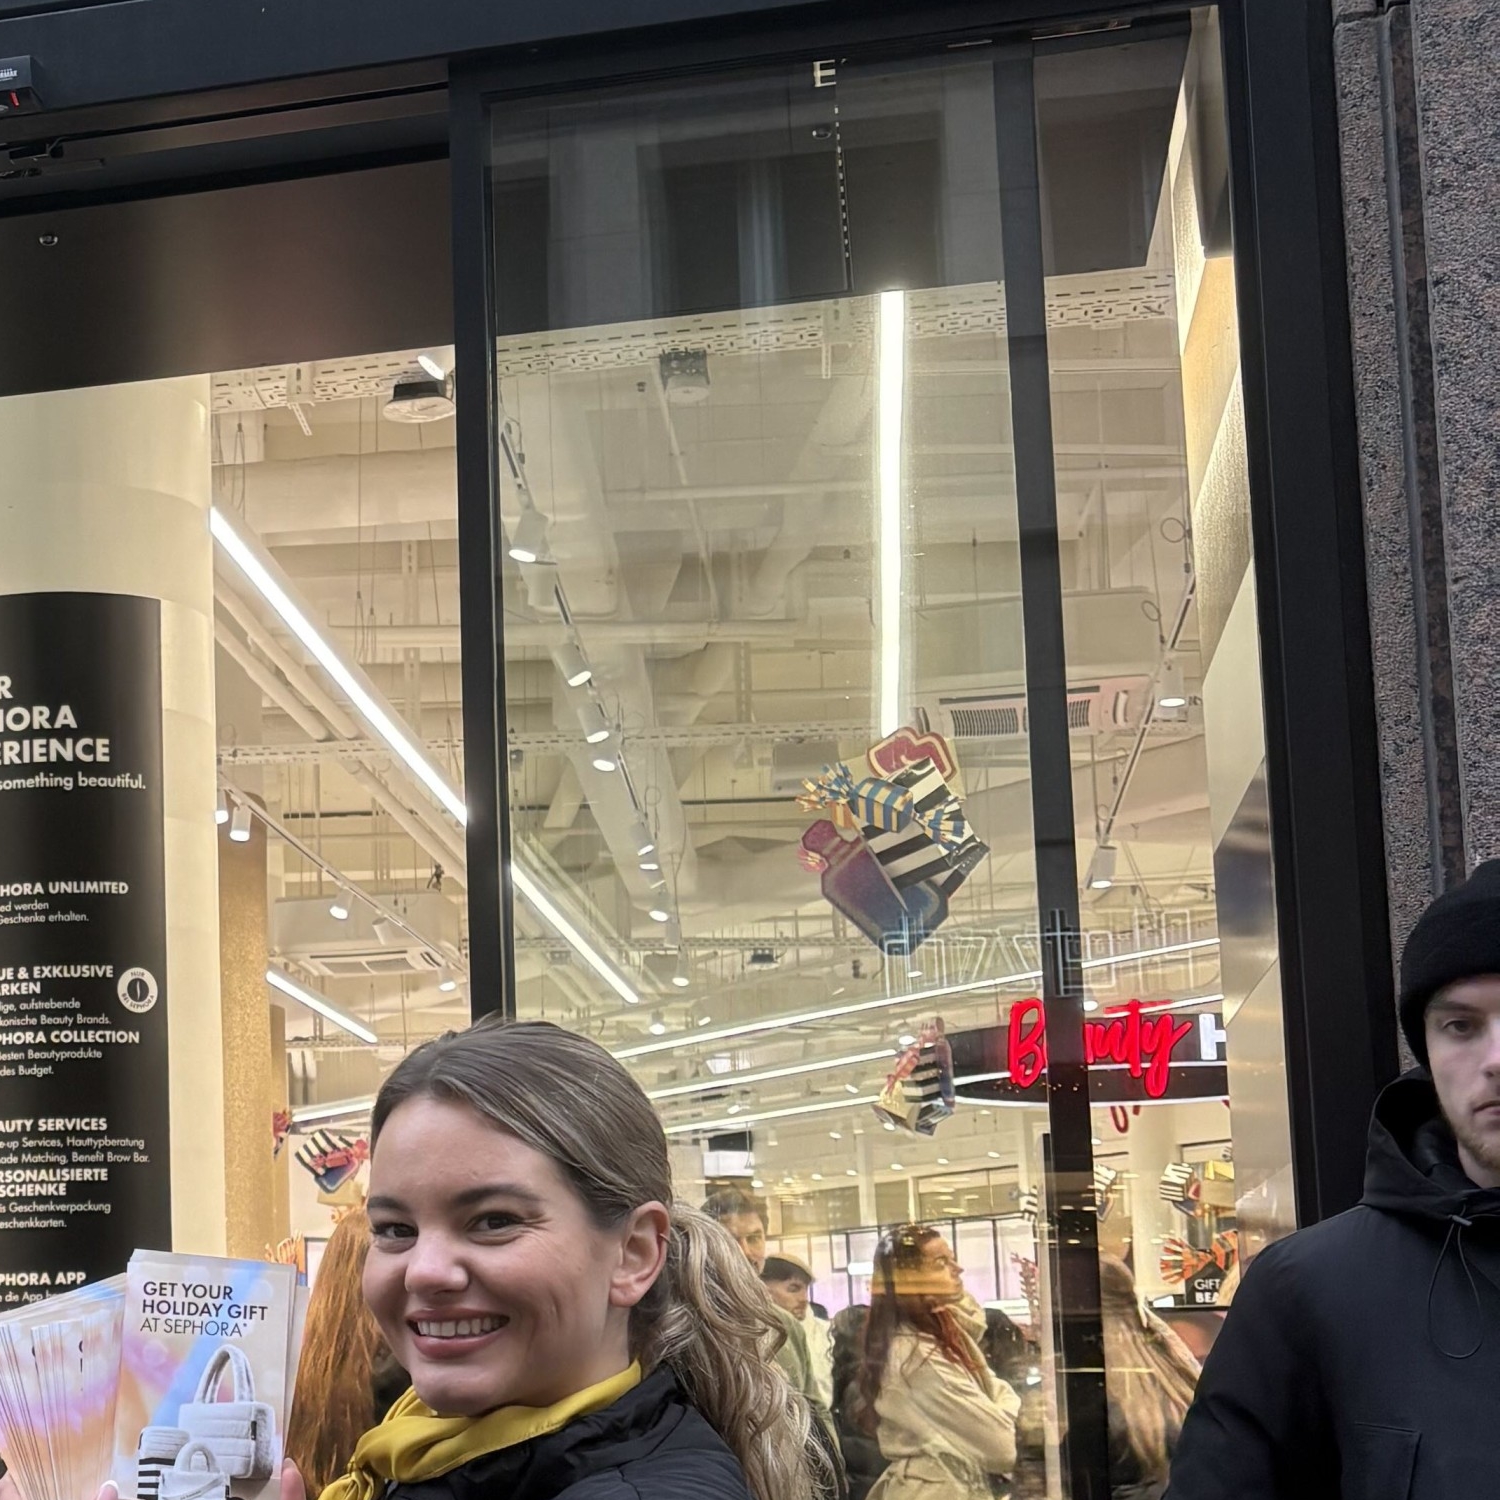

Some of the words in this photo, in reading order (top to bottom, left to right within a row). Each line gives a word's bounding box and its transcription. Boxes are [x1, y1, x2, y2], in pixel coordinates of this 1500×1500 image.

[78, 771, 146, 789] beautiful.
[48, 881, 129, 895] UNLIMITED
[14, 900, 49, 911] werden
[48, 912, 89, 923] erhalten.
[17, 968, 30, 981] &
[33, 965, 114, 979] EXKLUSIVE
[19, 998, 81, 1010] aufstrebende
[40, 1014, 74, 1027] Beauty
[76, 1013, 112, 1025] Brands.
[50, 1030, 140, 1044] COLLECTION
[27, 1047, 102, 1061] Beautyprodukte
[18, 1063, 54, 1077] Budget.
[37, 1117, 108, 1132] SERVICES
[21, 1136, 64, 1149] Services,
[66, 1136, 145, 1150] Hauttypberatung
[21, 1152, 69, 1166] Matching,
[72, 1151, 104, 1163] Benefit
[106, 1152, 131, 1163] Brow
[133, 1152, 150, 1163] Bar.
[8, 1200, 111, 1215] Geschenkverpackung
[55, 1271, 87, 1284] APP
[1194, 1278, 1220, 1290] GIFT
[5, 1291, 19, 1302] die
[22, 1291, 44, 1302] App
[143, 1281, 178, 1297] GET
[182, 1283, 233, 1300] YOUR
[142, 1299, 223, 1317] HOLIDAY
[227, 1304, 268, 1320] GIFT
[140, 1317, 161, 1332] AT
